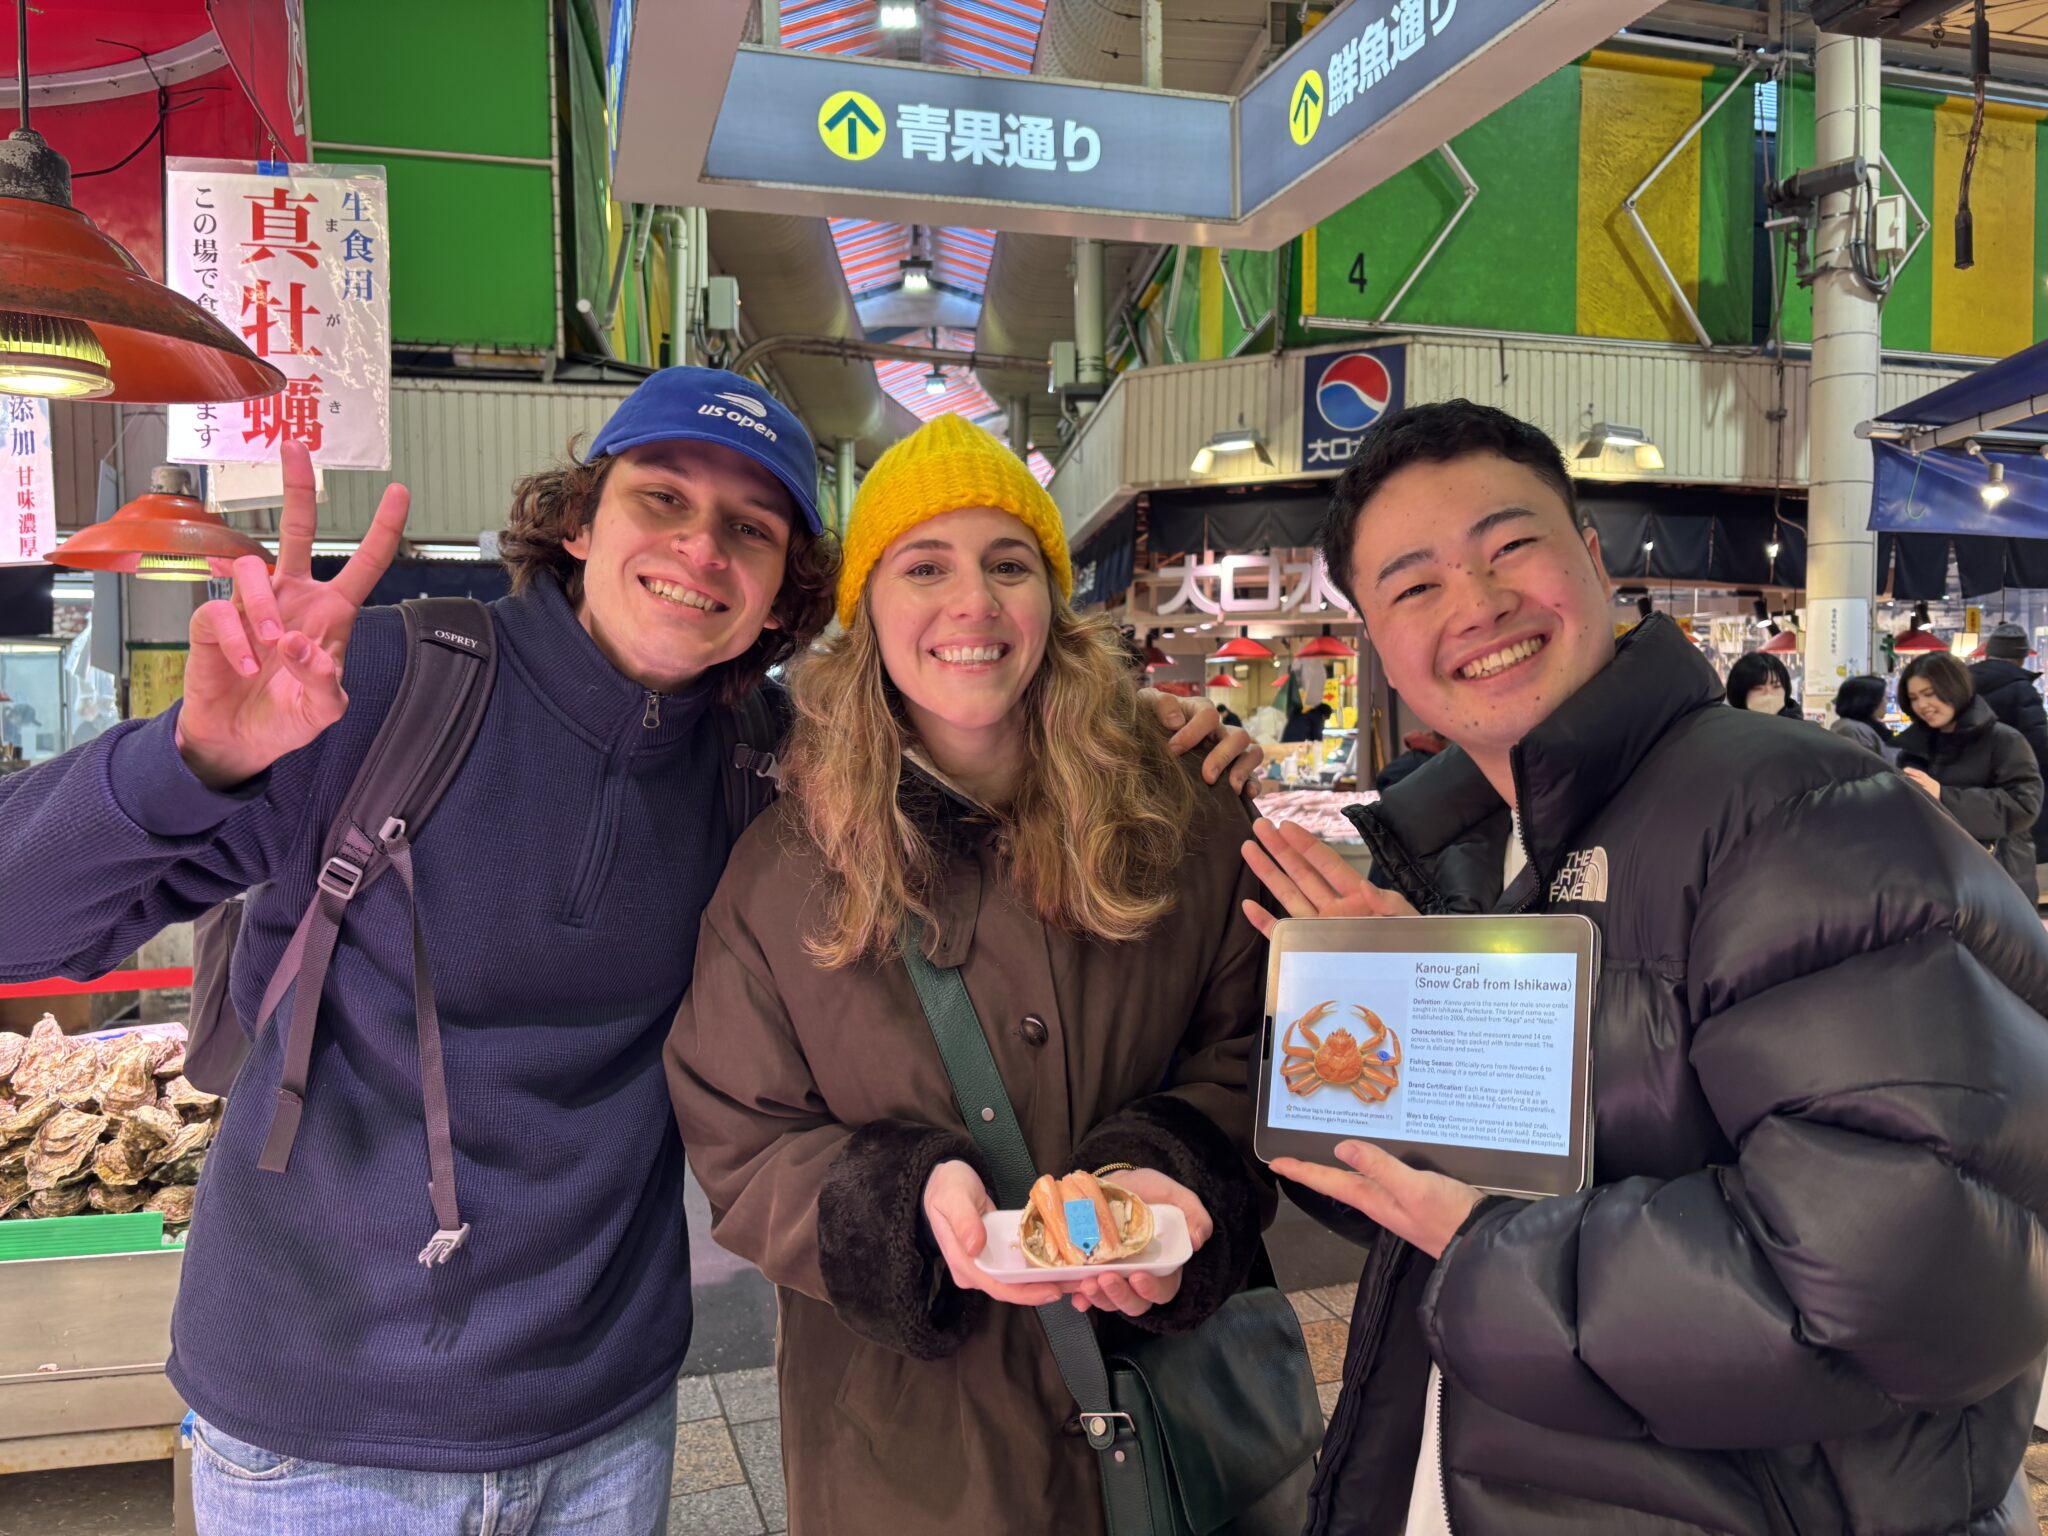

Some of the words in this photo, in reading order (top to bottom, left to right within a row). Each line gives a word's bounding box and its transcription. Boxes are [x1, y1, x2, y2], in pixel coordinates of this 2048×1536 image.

[896, 103, 1101, 172] 青果通り
[340, 191, 375, 302] 生食用
[1348, 252, 1368, 294] 4
[240, 187, 324, 452] 真牡蠣
[726, 411, 778, 443] open
[16, 465, 37, 558] 甘味濃厚
[435, 630, 478, 648] OSPREY
[1567, 849, 1594, 868] THE
[1552, 867, 1588, 886] RTH
[1415, 962, 1480, 976] Kanou-gani
[1415, 977, 1450, 989] (Snow
[1453, 978, 1480, 989] Crab
[1483, 978, 1510, 990] from
[1514, 978, 1572, 993] Ishikawa)
[1410, 1058, 1430, 1066] Fishing
[1455, 1061, 1480, 1069] Officially
[1426, 1098, 1448, 1106] product
[1498, 1096, 1526, 1104] certifying
[1406, 1112, 1421, 1120] Ways
[1486, 1127, 1497, 1135] pot
[1532, 1131, 1562, 1141] Especially
[1498, 1136, 1530, 1144] considered
